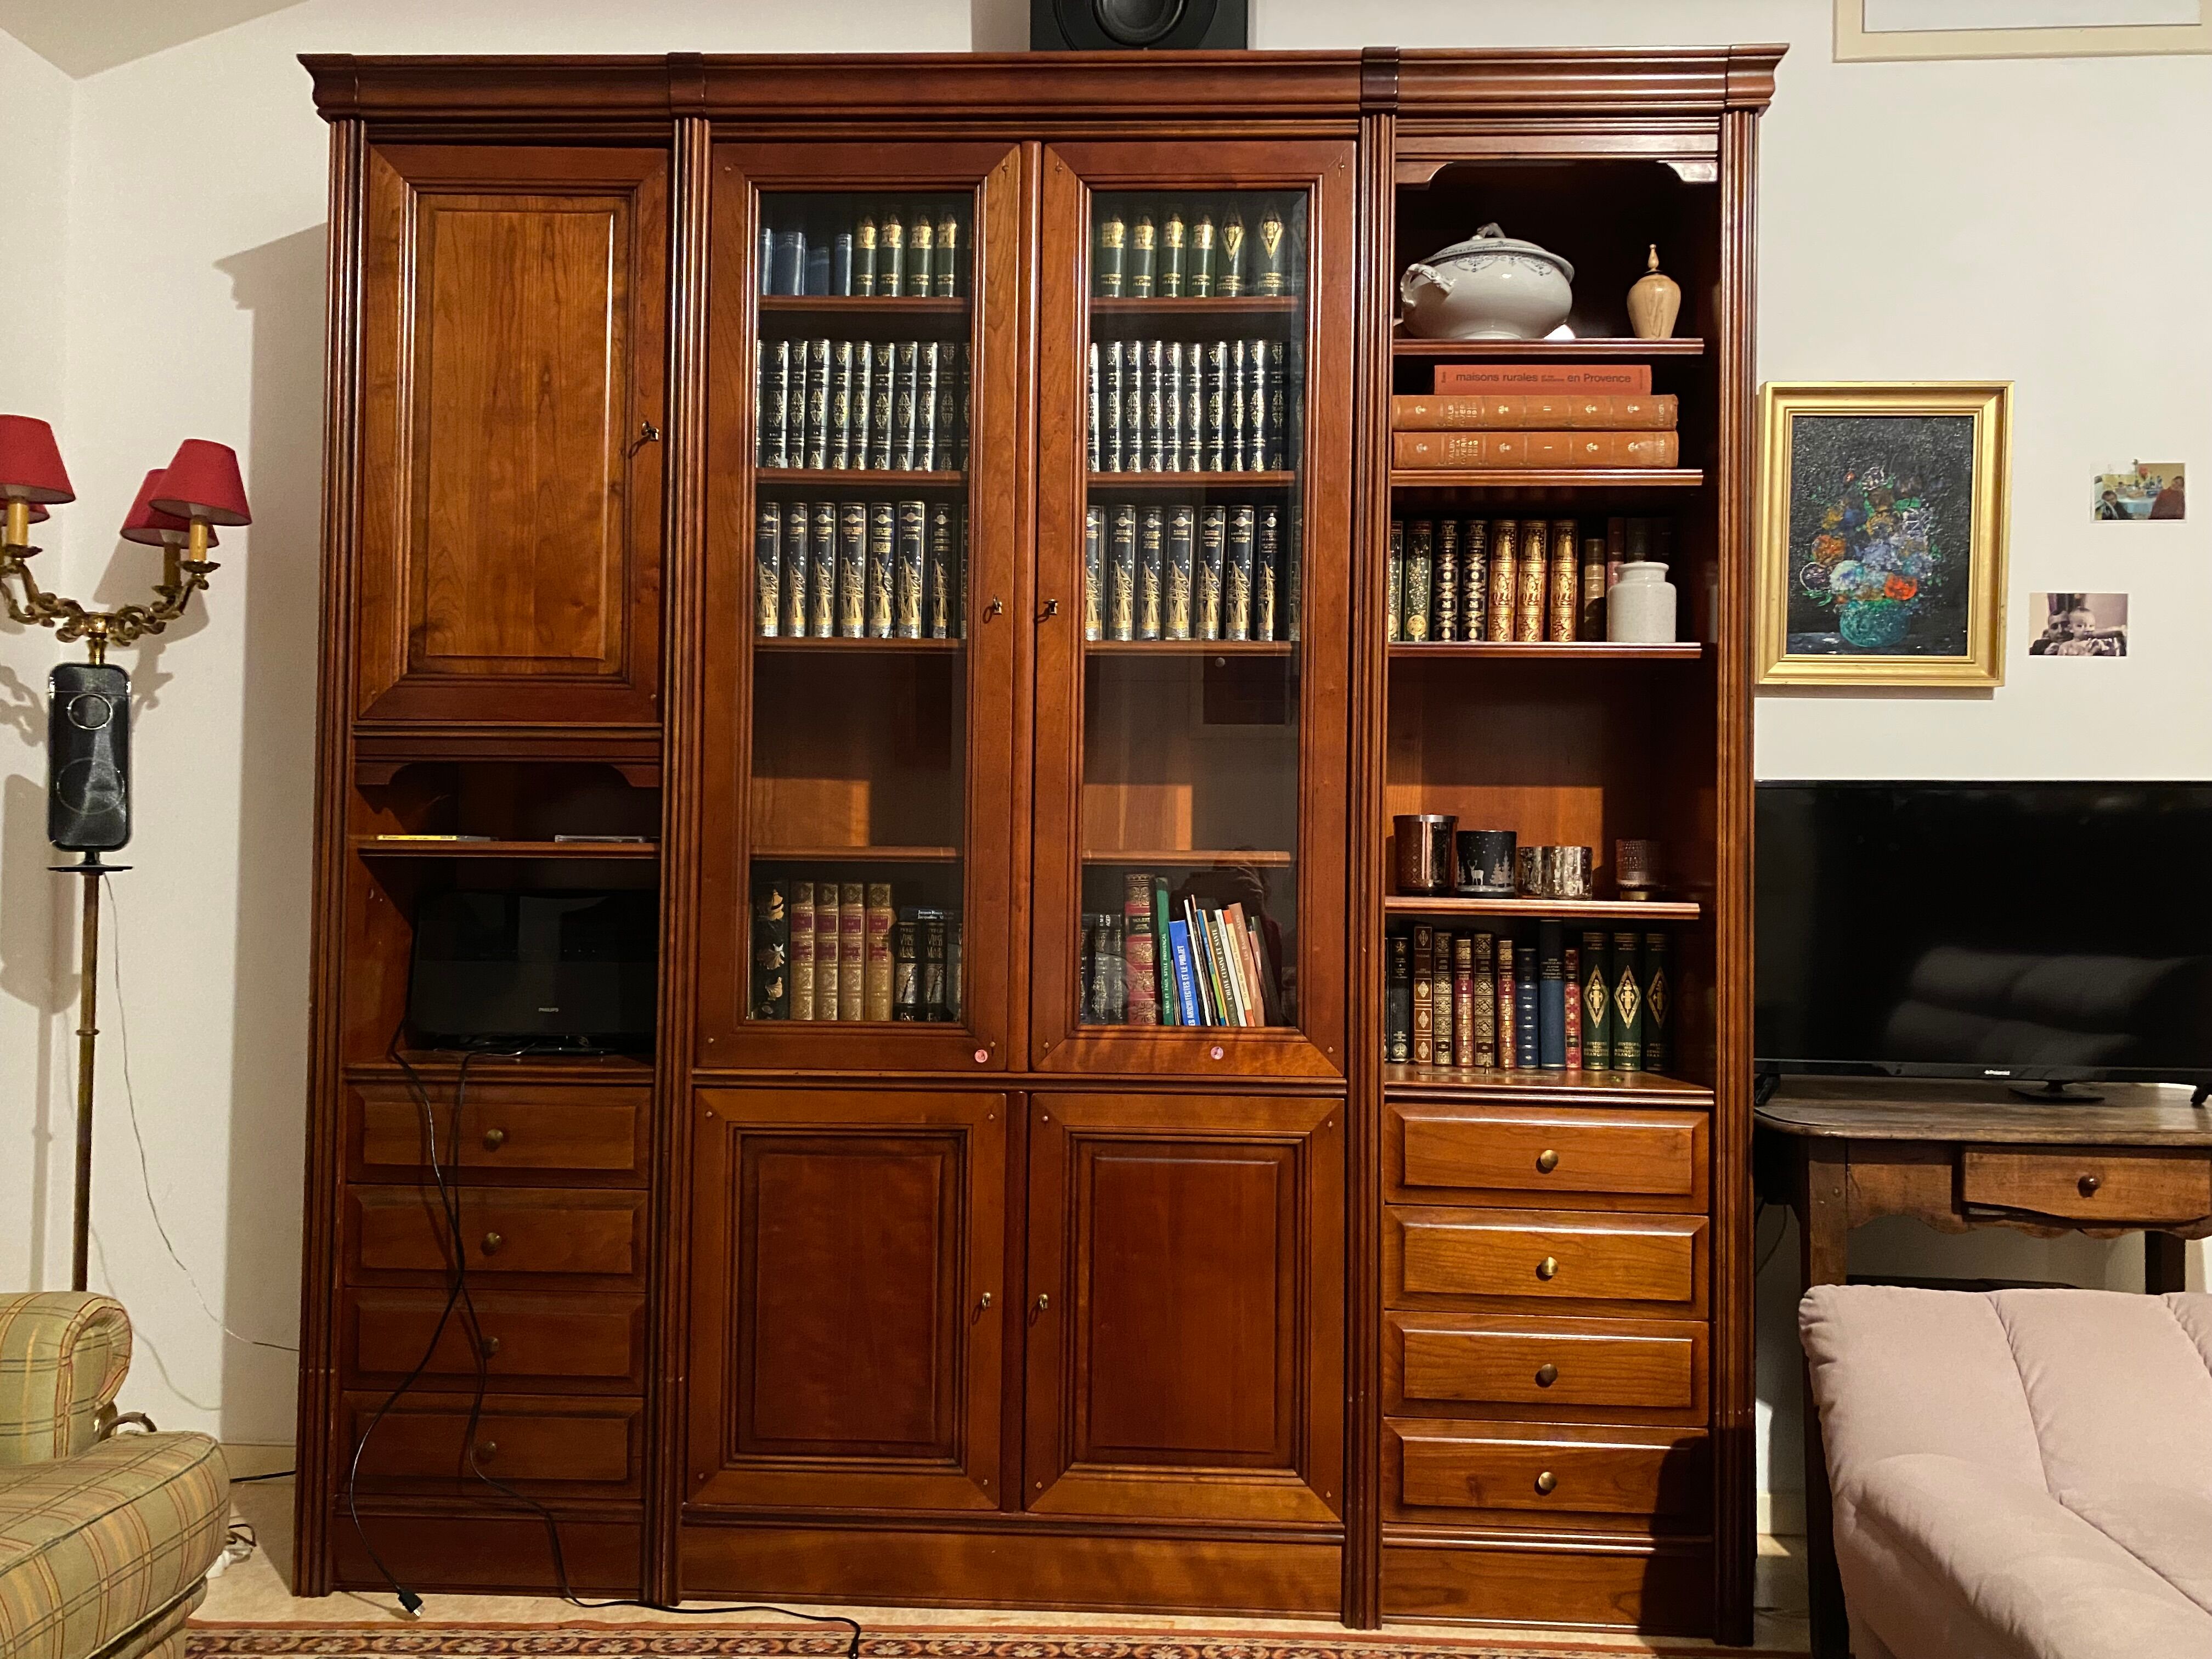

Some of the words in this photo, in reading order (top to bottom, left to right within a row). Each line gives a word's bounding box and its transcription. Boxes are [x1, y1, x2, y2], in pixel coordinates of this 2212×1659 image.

[1455, 373, 1499, 382] maisons
[1503, 373, 1537, 382] rurales
[1583, 373, 1631, 383] Provence
[1177, 945, 1187, 966] PROJET
[1180, 965, 1188, 973] LE
[1217, 956, 1228, 979] CUISINE
[1182, 981, 1194, 1019] ARCHITECTES
